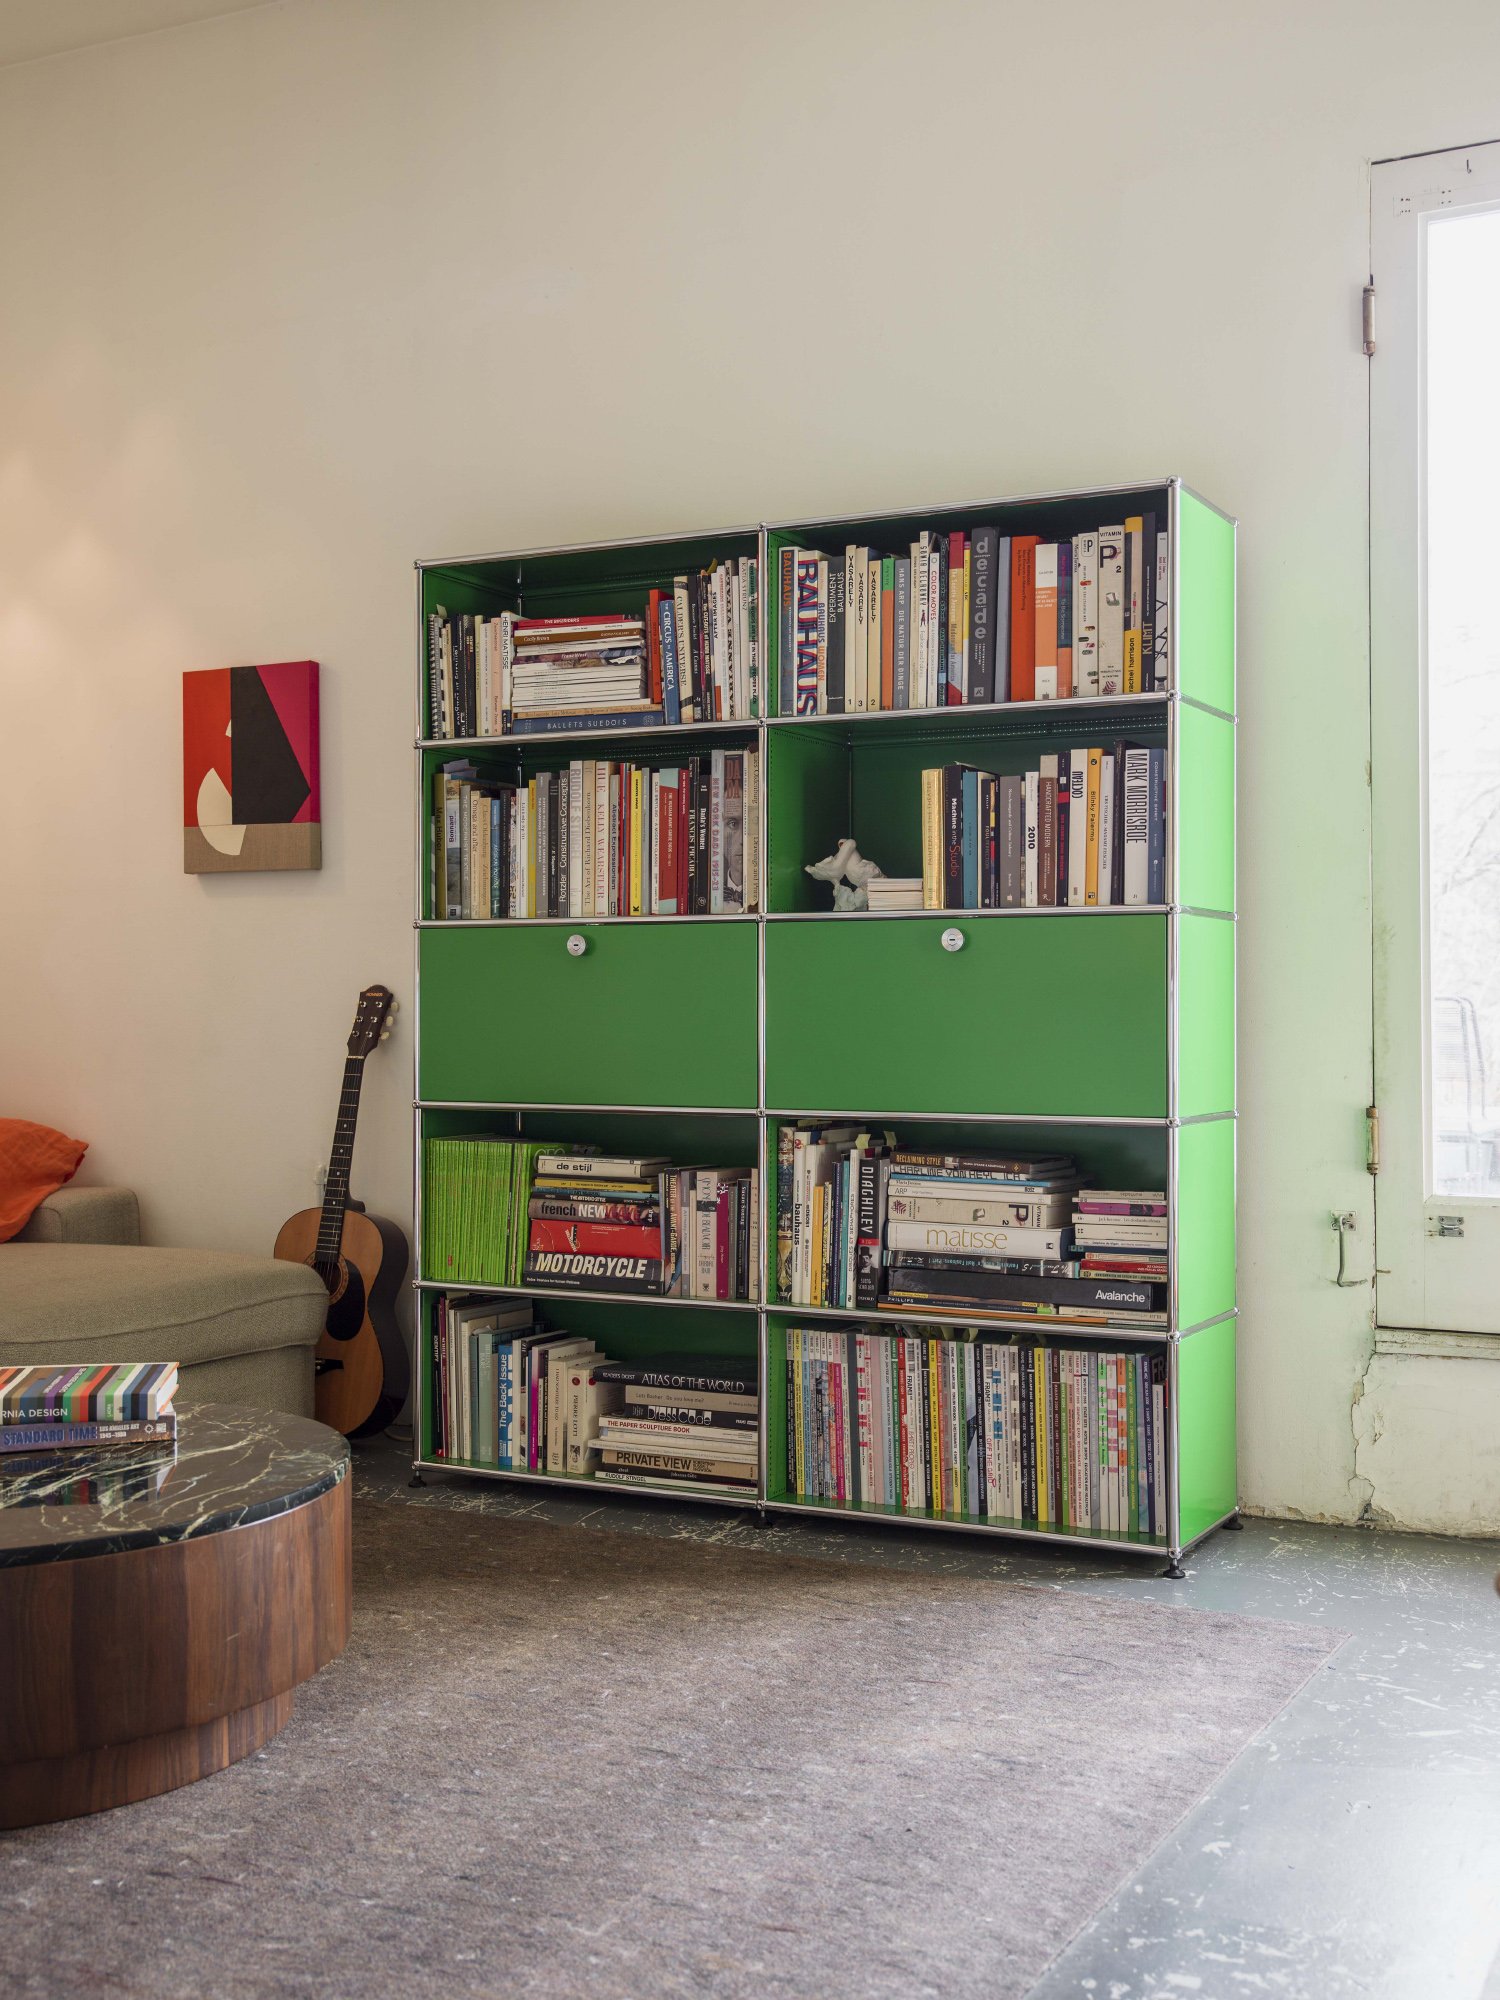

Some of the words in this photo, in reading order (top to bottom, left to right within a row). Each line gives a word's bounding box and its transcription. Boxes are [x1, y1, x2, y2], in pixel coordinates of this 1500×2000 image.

[919, 545, 927, 567] SONIA
[1087, 540, 1093, 553] P
[1100, 544, 1121, 568] P
[783, 551, 792, 606] BAUHAUS
[897, 567, 905, 588] HANS
[1115, 565, 1122, 574] 2
[828, 572, 837, 623] EXPERIMENT
[837, 571, 845, 613] BAUHAUS
[897, 590, 905, 605] ARP
[919, 569, 927, 606] DELAUNAY
[973, 536, 989, 639] decade
[663, 611, 672, 644] CIRCUS
[676, 596, 684, 640] CALDER'S
[897, 610, 905, 623] DIE
[796, 558, 818, 717] BAUHAUS
[897, 624, 905, 649] NATUR
[1142, 620, 1153, 655] KLIMT
[679, 640, 687, 686] UNIVERSE
[1127, 637, 1135, 669] harrison
[665, 651, 675, 691] AMERICA
[727, 628, 735, 717] MARIANNE
[547, 721, 583, 730] BALLETS
[597, 767, 606, 793] HUE
[1126, 753, 1148, 783] MARK
[559, 777, 568, 817] Concepts
[571, 768, 582, 813] RUDOLF
[712, 777, 720, 798] NEW
[1071, 770, 1084, 799] COCTEAU
[471, 799, 479, 823] Omega
[1044, 781, 1052, 823] HANDCRAFTED
[1089, 790, 1097, 812] Blinky
[597, 803, 606, 834] KELLY
[688, 809, 696, 843] FRANCIS
[699, 808, 707, 828] Dada's
[1126, 785, 1148, 844] MORRISROE
[699, 828, 707, 850] Women
[1027, 825, 1036, 850] 2010
[1044, 823, 1052, 848] MODERN
[1089, 813, 1097, 842] Palermo
[559, 817, 568, 868] Constructive
[584, 868, 591, 876] of
[597, 838, 605, 899] WEARSTLER
[688, 845, 696, 877] PICABIA
[949, 844, 961, 877] Studio
[559, 874, 568, 903] Rotzler
[556, 1162, 569, 1171] de
[572, 1163, 592, 1173] stijl
[896, 1154, 925, 1166] RECLAIMING
[926, 1157, 941, 1167] STYLE
[669, 1174, 679, 1198] THEATER
[541, 1201, 576, 1217] french
[577, 1203, 606, 1219] NEW
[860, 1166, 874, 1234] DIAGHILEV
[793, 1202, 803, 1246] bauhaus
[1008, 1204, 1029, 1222] P
[669, 1212, 679, 1253] AVANT-GARDE,
[926, 1228, 1008, 1250] matisse
[534, 1252, 648, 1279] MOTORCYCLE
[888, 1296, 914, 1304] PHILLIPS
[1095, 1289, 1146, 1303] Avalanche
[500, 1354, 508, 1380] Issue
[641, 1373, 670, 1386] ATLAS
[671, 1376, 684, 1388] OF
[684, 1377, 707, 1390] THE
[706, 1379, 745, 1393] WORLD
[28, 1407, 68, 1418] DESIGN
[647, 1405, 677, 1424] Dress
[678, 1408, 712, 1425] Code
[3, 1428, 66, 1446] STANDARD
[69, 1426, 98, 1441] TIME
[99, 1425, 108, 1433] LOS
[108, 1424, 128, 1432] ANGELES
[129, 1423, 140, 1431] ART
[619, 1421, 638, 1429] PAPER
[638, 1423, 673, 1433] SCULPTURE
[673, 1426, 690, 1434] BOOK
[616, 1452, 661, 1468] PRIVATE
[662, 1456, 692, 1471] VIEW
[625, 1474, 647, 1482] STINGEL
